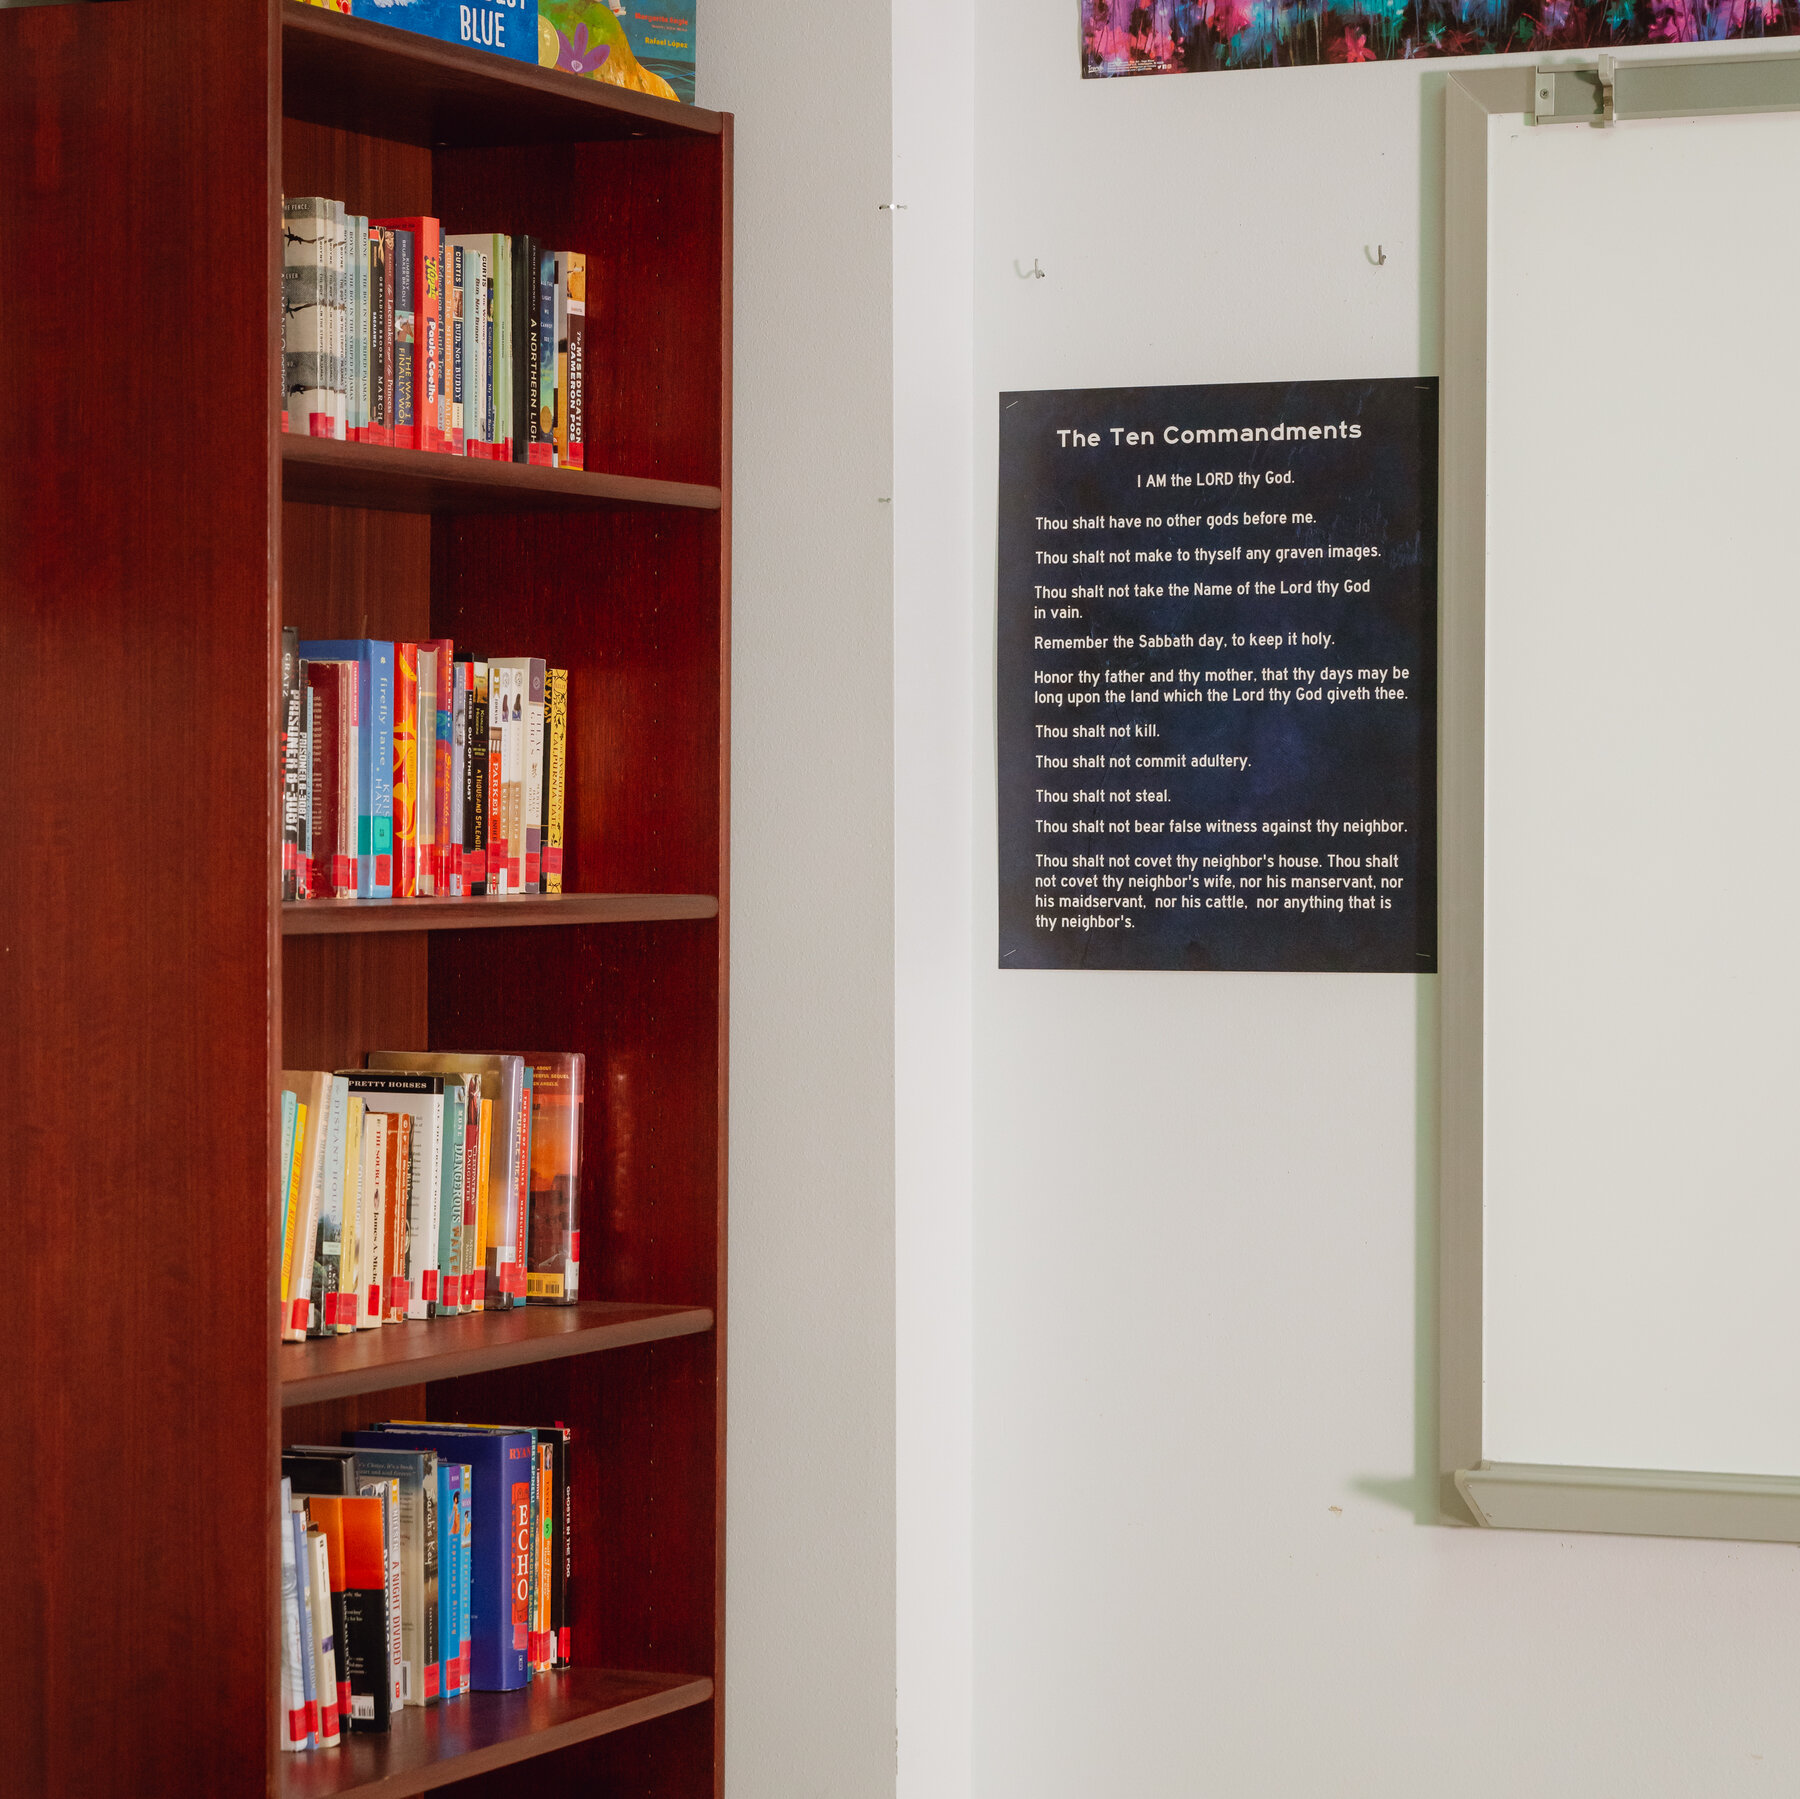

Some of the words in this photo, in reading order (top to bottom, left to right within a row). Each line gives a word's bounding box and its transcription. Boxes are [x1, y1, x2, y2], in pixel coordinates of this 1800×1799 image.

[460, 5, 505, 47] BLUE
[645, 36, 667, 46] Rafael
[531, 318, 537, 327] A
[428, 321, 437, 358] Paulo
[454, 347, 462, 365] Not
[427, 361, 436, 403] Coelho
[454, 367, 462, 400] BUDDY
[1056, 429, 1101, 448] The
[1110, 428, 1154, 446] Ten
[1163, 420, 1362, 444] Commandments
[1137, 474, 1141, 488] I
[1146, 474, 1166, 488] AM
[1171, 473, 1192, 487] the
[1197, 472, 1233, 486] LORD
[1238, 472, 1261, 489] thy
[1265, 470, 1295, 484] God.
[1035, 517, 1068, 530] Thou
[1072, 515, 1105, 529] shalt
[1109, 515, 1142, 528] have
[1146, 517, 1162, 527] no
[1166, 513, 1202, 527] other
[1206, 512, 1239, 530] gods
[1243, 511, 1287, 525] before
[1292, 513, 1316, 524] me.
[1035, 551, 1068, 564] Thou
[1072, 550, 1105, 564] shalt
[1109, 549, 1131, 563] not
[1135, 549, 1172, 562] make
[1176, 548, 1190, 561] to
[1194, 546, 1241, 565] thyself
[1246, 549, 1271, 564] any
[1275, 548, 1323, 563] graven
[1328, 544, 1381, 561] images.
[1034, 585, 1067, 599] Thou
[1071, 585, 1104, 598] shalt
[1108, 584, 1130, 597] not
[1134, 584, 1164, 597] take
[1168, 583, 1189, 596] the
[1194, 582, 1232, 596] Name
[1237, 581, 1250, 595] of
[1254, 581, 1276, 595] the
[1280, 580, 1312, 594] Lord
[1316, 580, 1339, 597] thy
[1344, 579, 1370, 593] God
[1034, 606, 1046, 619] in
[1050, 605, 1083, 619] vain.
[1034, 636, 1109, 649] Remember
[1113, 635, 1134, 648] the
[1139, 634, 1194, 648] Sabbath
[1198, 633, 1227, 651] day,
[1231, 633, 1245, 646] to
[1249, 633, 1283, 650] keep
[1288, 632, 1298, 645] it
[1302, 632, 1335, 649] holy.
[1034, 670, 1074, 684] Honor
[1078, 670, 1100, 687] thy
[1104, 669, 1145, 683] father
[1150, 669, 1174, 682] and
[1178, 669, 1201, 686] thy
[1205, 668, 1257, 682] mother,
[1261, 667, 1288, 681] that
[1292, 667, 1315, 684] thy
[1320, 667, 1353, 684] days
[1358, 669, 1388, 683] may
[1393, 666, 1409, 679] be
[378, 677, 388, 724] firefly
[1035, 690, 1063, 707] long
[1067, 693, 1100, 707] upon
[1104, 690, 1126, 703] the
[1131, 689, 1159, 703] land
[1163, 689, 1202, 702] which
[1207, 688, 1228, 702] the
[1233, 688, 1264, 701] Lord
[1268, 688, 1291, 705] thy
[1296, 687, 1322, 701] God
[1327, 686, 1370, 704] giveth
[1374, 686, 1408, 700] thee.
[1035, 725, 1068, 738] Thou
[1072, 724, 1105, 738] shalt
[1109, 724, 1131, 737] not
[1135, 724, 1160, 737] kill.
[299, 732, 307, 781] PRISONER
[467, 747, 473, 759] OF
[1035, 755, 1068, 768] Thou
[1072, 755, 1105, 768] shalt
[1109, 754, 1131, 768] not
[1135, 754, 1187, 768] commit
[1191, 754, 1251, 771] adultery.
[1035, 789, 1068, 803] Thou
[1073, 789, 1105, 802] shalt
[1109, 789, 1131, 802] not
[1135, 789, 1171, 802] steal.
[1035, 819, 1067, 833] Thou
[1072, 819, 1105, 833] shalt
[1109, 820, 1130, 833] not
[1135, 819, 1165, 833] bear
[1169, 819, 1202, 833] false
[1206, 819, 1257, 833] witness
[1262, 819, 1312, 836] against
[1316, 819, 1339, 837] thy
[1343, 819, 1407, 836] neighbor.
[1035, 854, 1068, 867] Thou
[1072, 854, 1105, 867] shalt
[1109, 854, 1130, 867] not
[1134, 854, 1172, 867] covet
[1176, 854, 1198, 872] thy
[1203, 854, 1274, 871] neighbor's
[1279, 854, 1322, 868] house.
[1327, 854, 1360, 868] Thou
[1365, 854, 1399, 868] shalt
[1035, 874, 1056, 887] not
[1061, 874, 1098, 887] covet
[1102, 874, 1124, 892] thy
[1129, 874, 1199, 892] neighbor's
[1204, 874, 1235, 889] wife,
[1240, 877, 1262, 888] nor
[1267, 874, 1286, 888] his
[1291, 875, 1376, 889] manservant,
[1381, 878, 1404, 888] nor
[1035, 894, 1055, 907] his
[1059, 894, 1146, 909] maidservant,
[1155, 898, 1177, 908] nor
[1181, 895, 1201, 908] his
[1205, 895, 1248, 909] cattle,
[1257, 898, 1279, 908] nor
[1284, 895, 1343, 913] anything
[1348, 895, 1376, 909] that
[1380, 895, 1392, 909] is
[1035, 914, 1057, 932] thy
[1061, 914, 1135, 932] neighbor's.
[348, 1080, 386, 1088] PRETTY
[388, 1081, 427, 1089] HORSES
[452, 1144, 463, 1223] DANGEROUS
[426, 1488, 435, 1537] Sarah's
[565, 1526, 571, 1535] IN
[425, 1541, 434, 1565] Key
[517, 1505, 528, 1600] ECHO
[392, 1561, 399, 1570] A
[392, 1573, 400, 1613] NIGHT
[393, 1616, 401, 1665] DIVIDED
